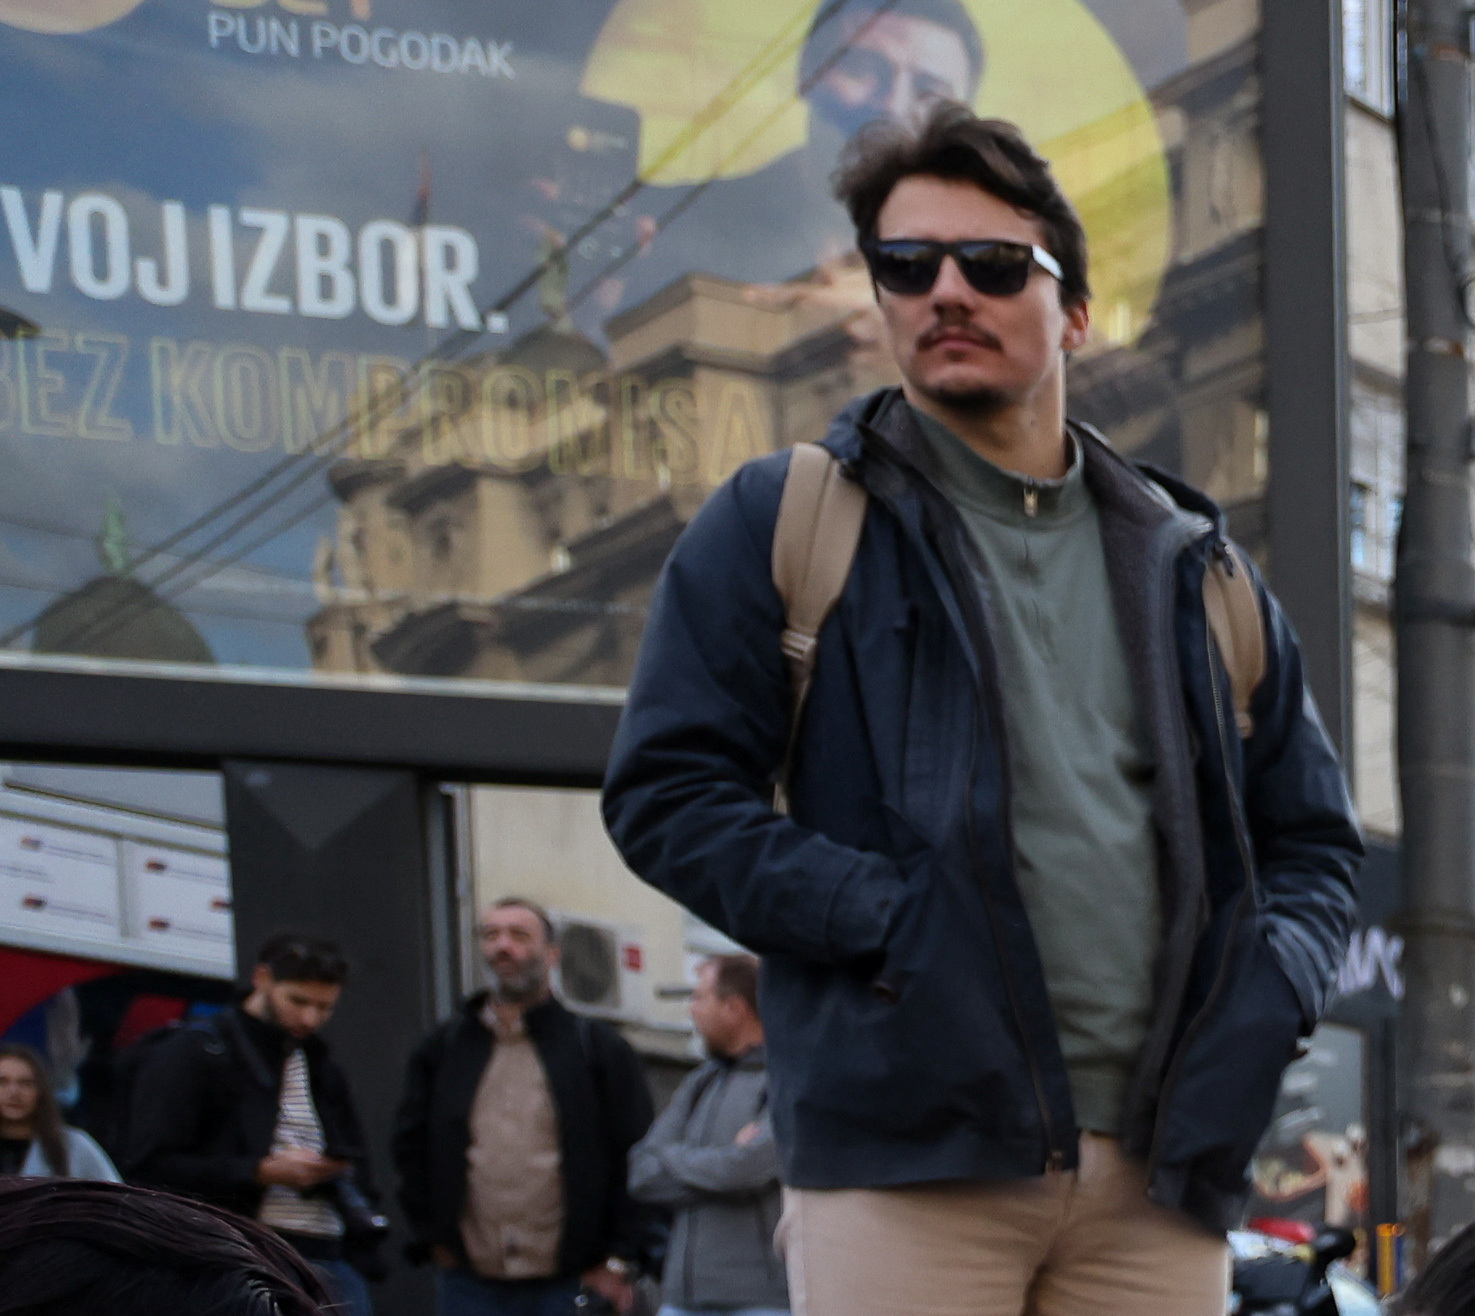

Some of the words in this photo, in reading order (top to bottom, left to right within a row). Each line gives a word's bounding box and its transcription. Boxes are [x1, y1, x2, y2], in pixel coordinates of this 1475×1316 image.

[206, 11, 300, 58] PUN
[309, 20, 516, 80] POGODAK
[207, 205, 510, 334] IZBOR.
